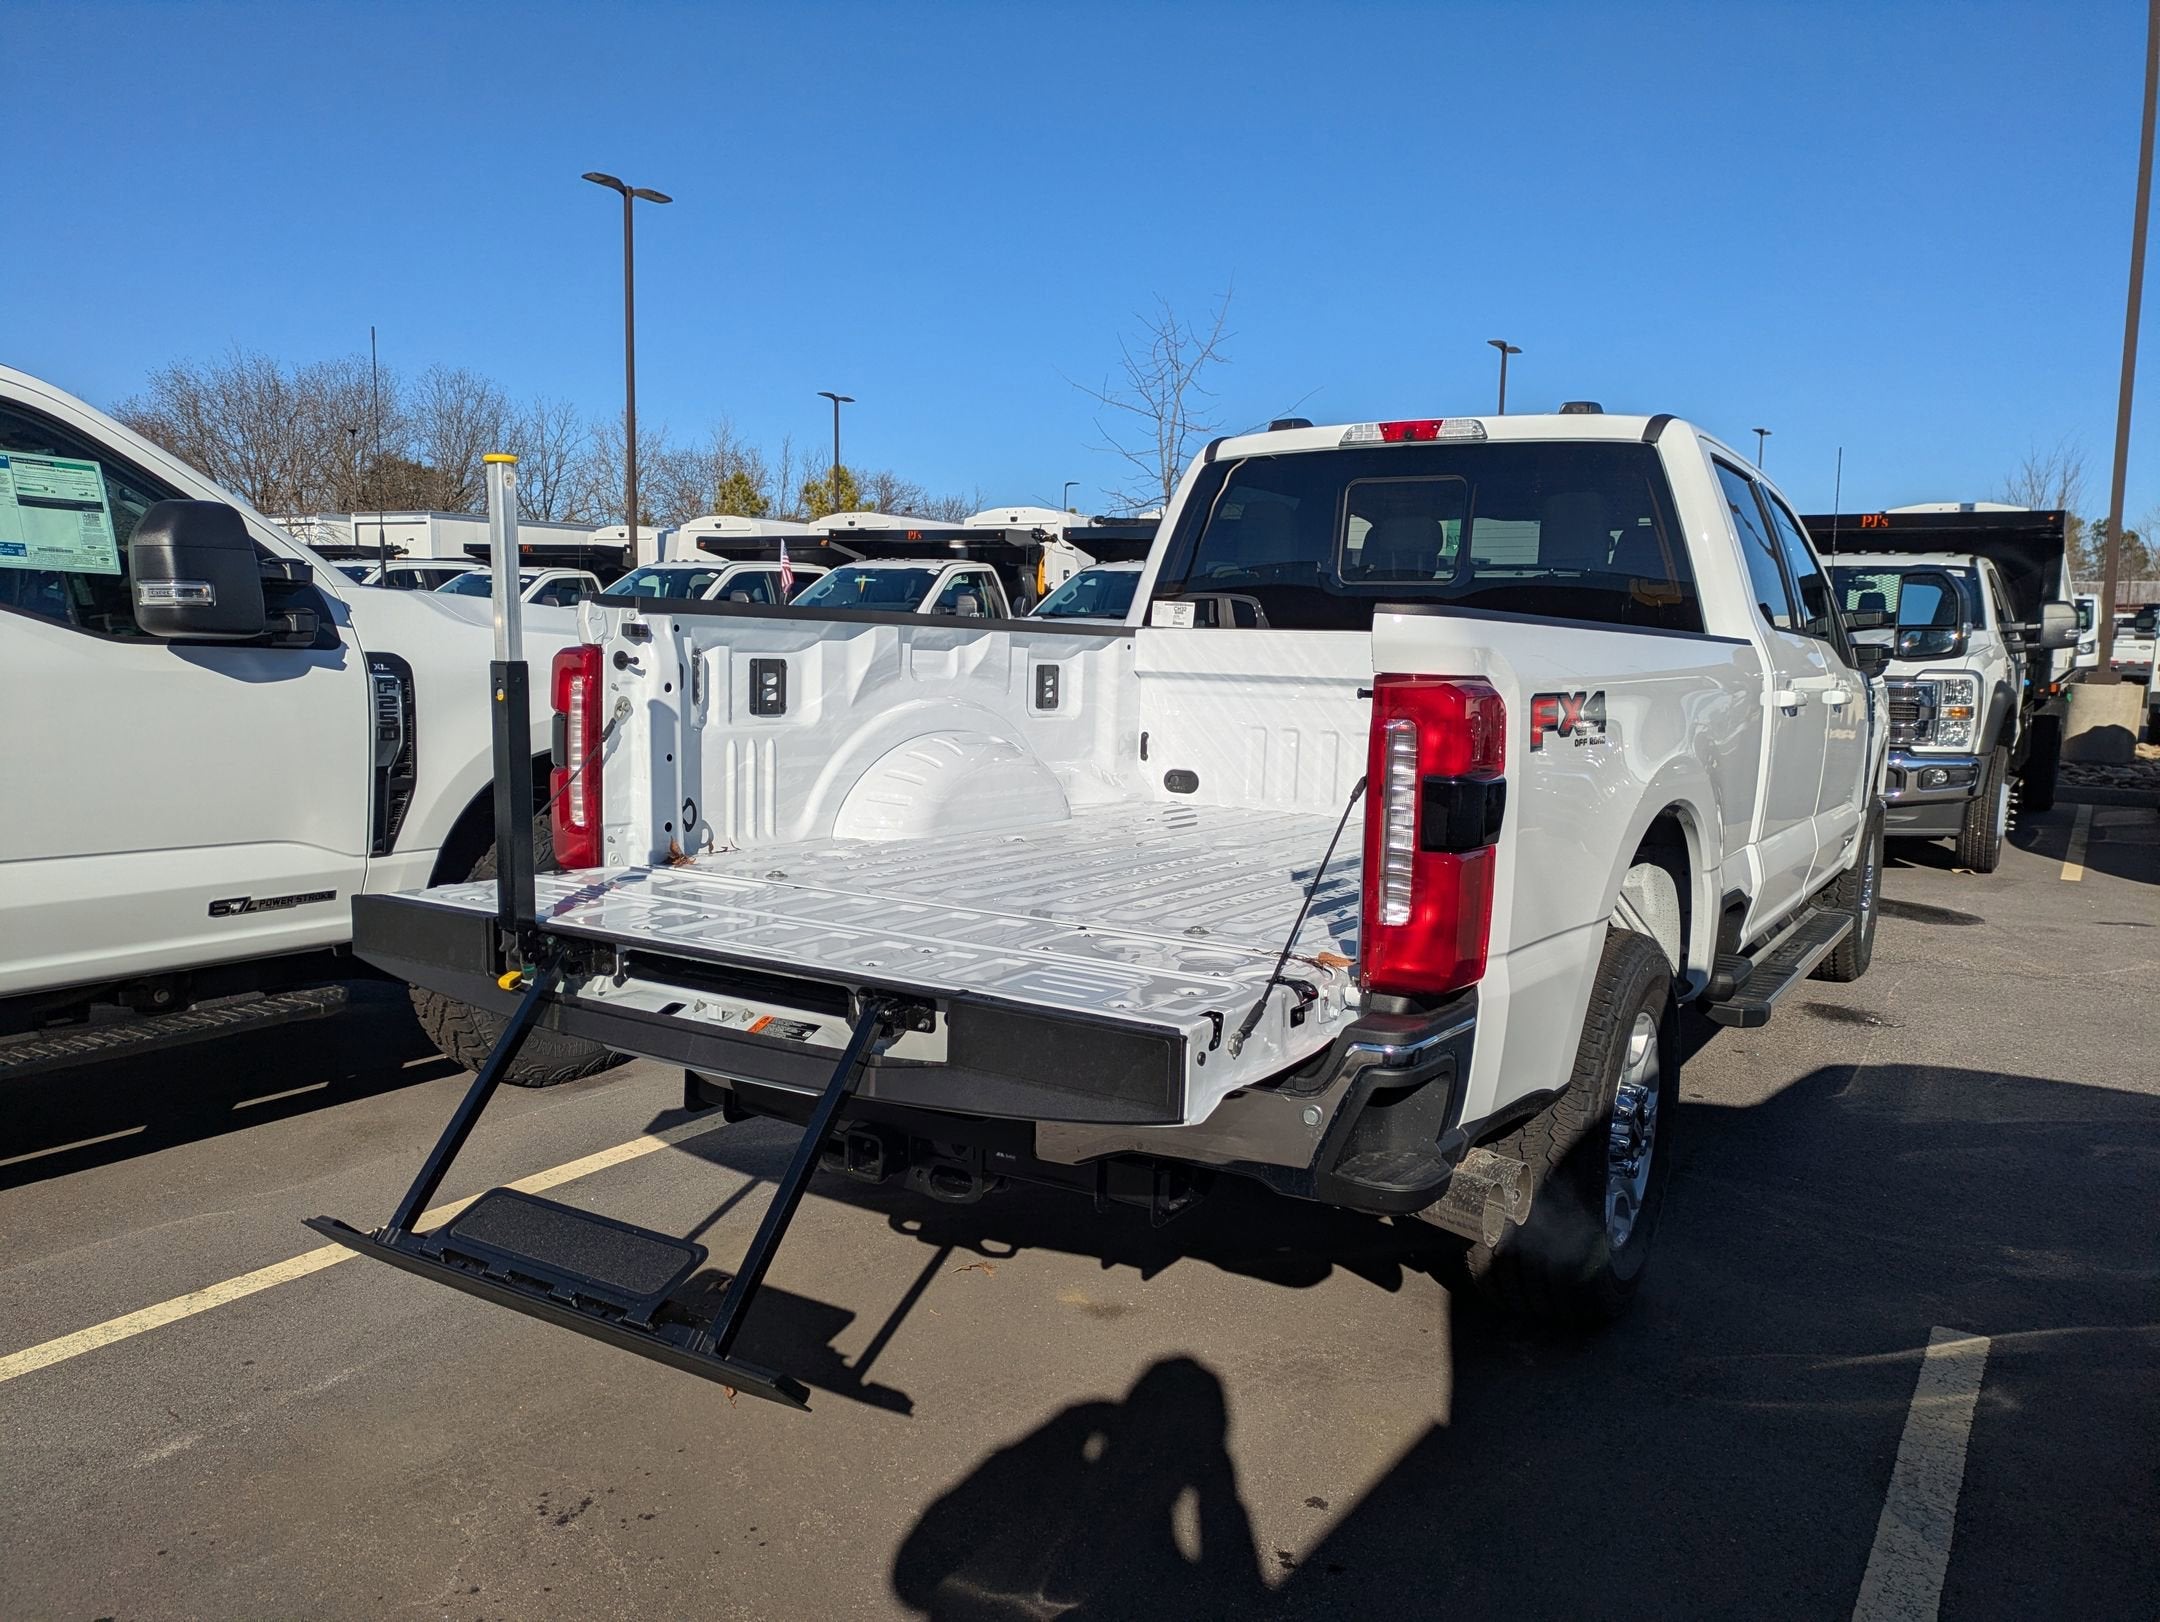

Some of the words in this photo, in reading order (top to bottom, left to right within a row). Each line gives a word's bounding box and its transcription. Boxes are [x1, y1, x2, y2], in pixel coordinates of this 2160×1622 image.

[1861, 514, 1889, 528] PJ's
[373, 662, 391, 671] XL
[1530, 690, 1607, 753] FX4
[1574, 738, 1588, 748] OFF
[259, 897, 294, 909] POWER
[296, 891, 334, 903] STROKE
